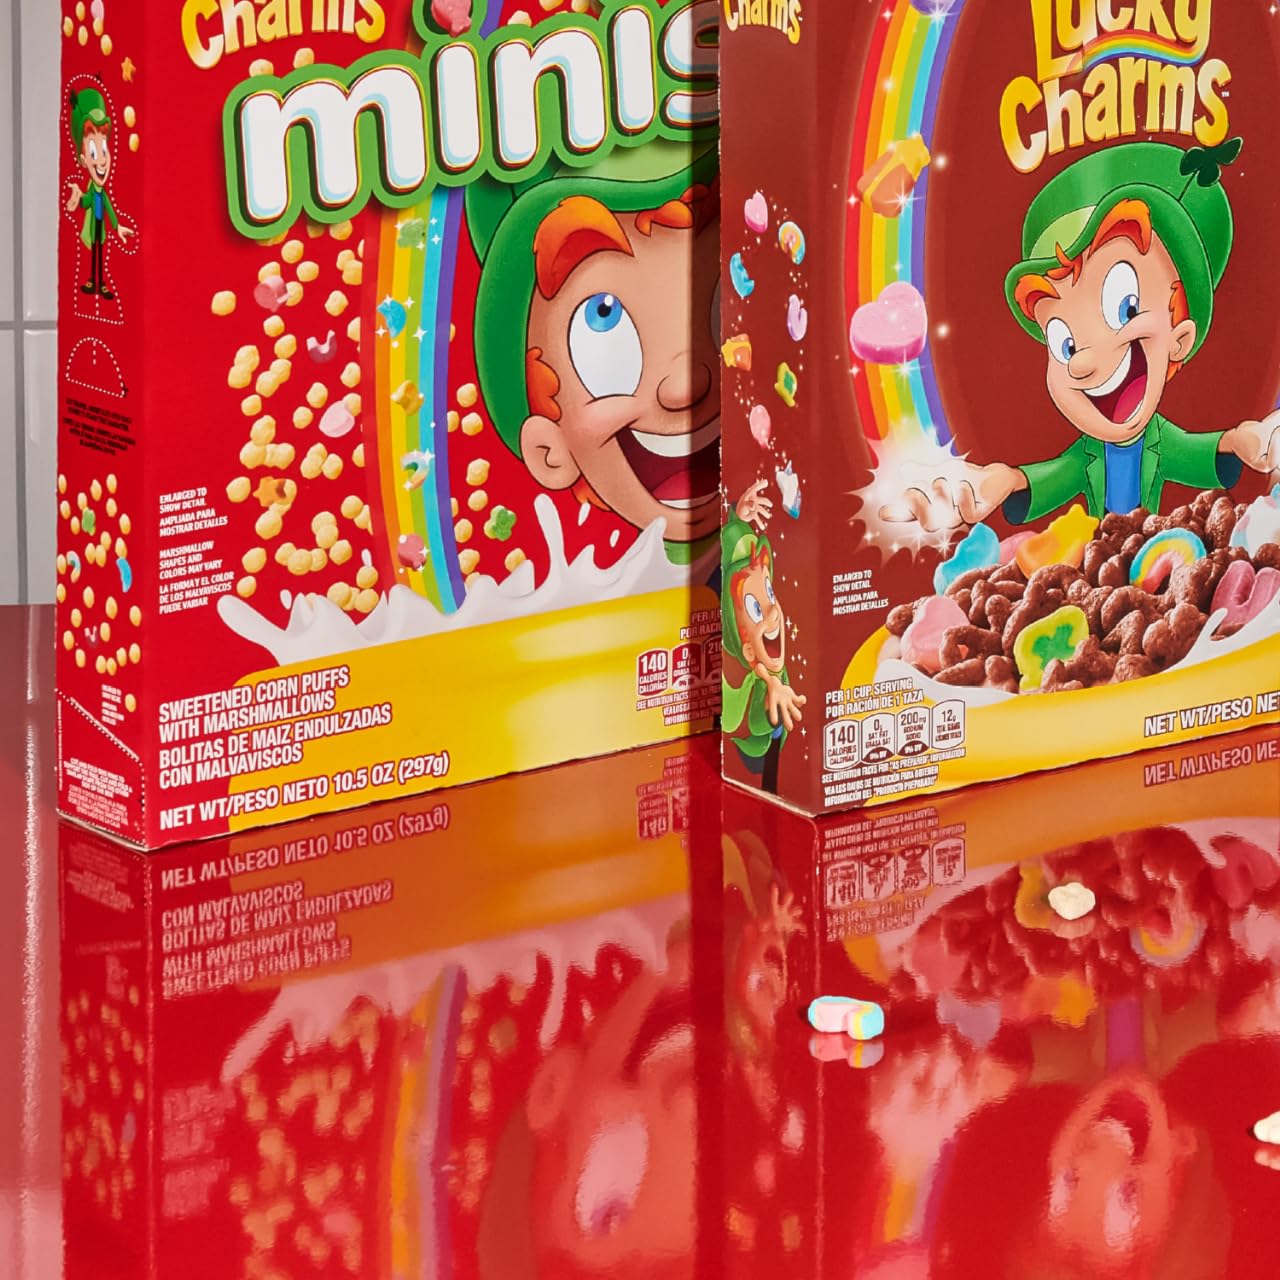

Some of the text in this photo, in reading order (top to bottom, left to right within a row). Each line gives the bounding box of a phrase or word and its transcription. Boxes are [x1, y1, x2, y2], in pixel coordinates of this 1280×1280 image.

[1000, 57, 1232, 174] Charms
[160, 488, 206, 503] ENLARGED TO
[160, 498, 206, 513] SHOW DETAIL
[160, 508, 215, 526] AMPLIADA PARA
[160, 516, 228, 537] MOSTRAR DETALLES
[641, 653, 666, 673] 140
[160, 666, 349, 722] SWEETENED CORN PUFFS
[826, 678, 912, 704] PER 1 CUP SERVING
[826, 690, 924, 718] POR RACIÓN DE 1 TAZA
[160, 717, 200, 743] WITH
[204, 690, 334, 735] MARSHMALLOWS
[1145, 712, 1177, 736] NET
[1180, 698, 1252, 729] WT/PESO
[160, 737, 224, 769] BOLITAS
[228, 732, 248, 755] DE
[295, 704, 391, 742] ENDULZADAS
[830, 725, 855, 746] 140
[160, 743, 302, 789] CON MALVAVISCOS
[160, 754, 449, 830] NET WT/PESO NETO 10.5 OZ (297g)
